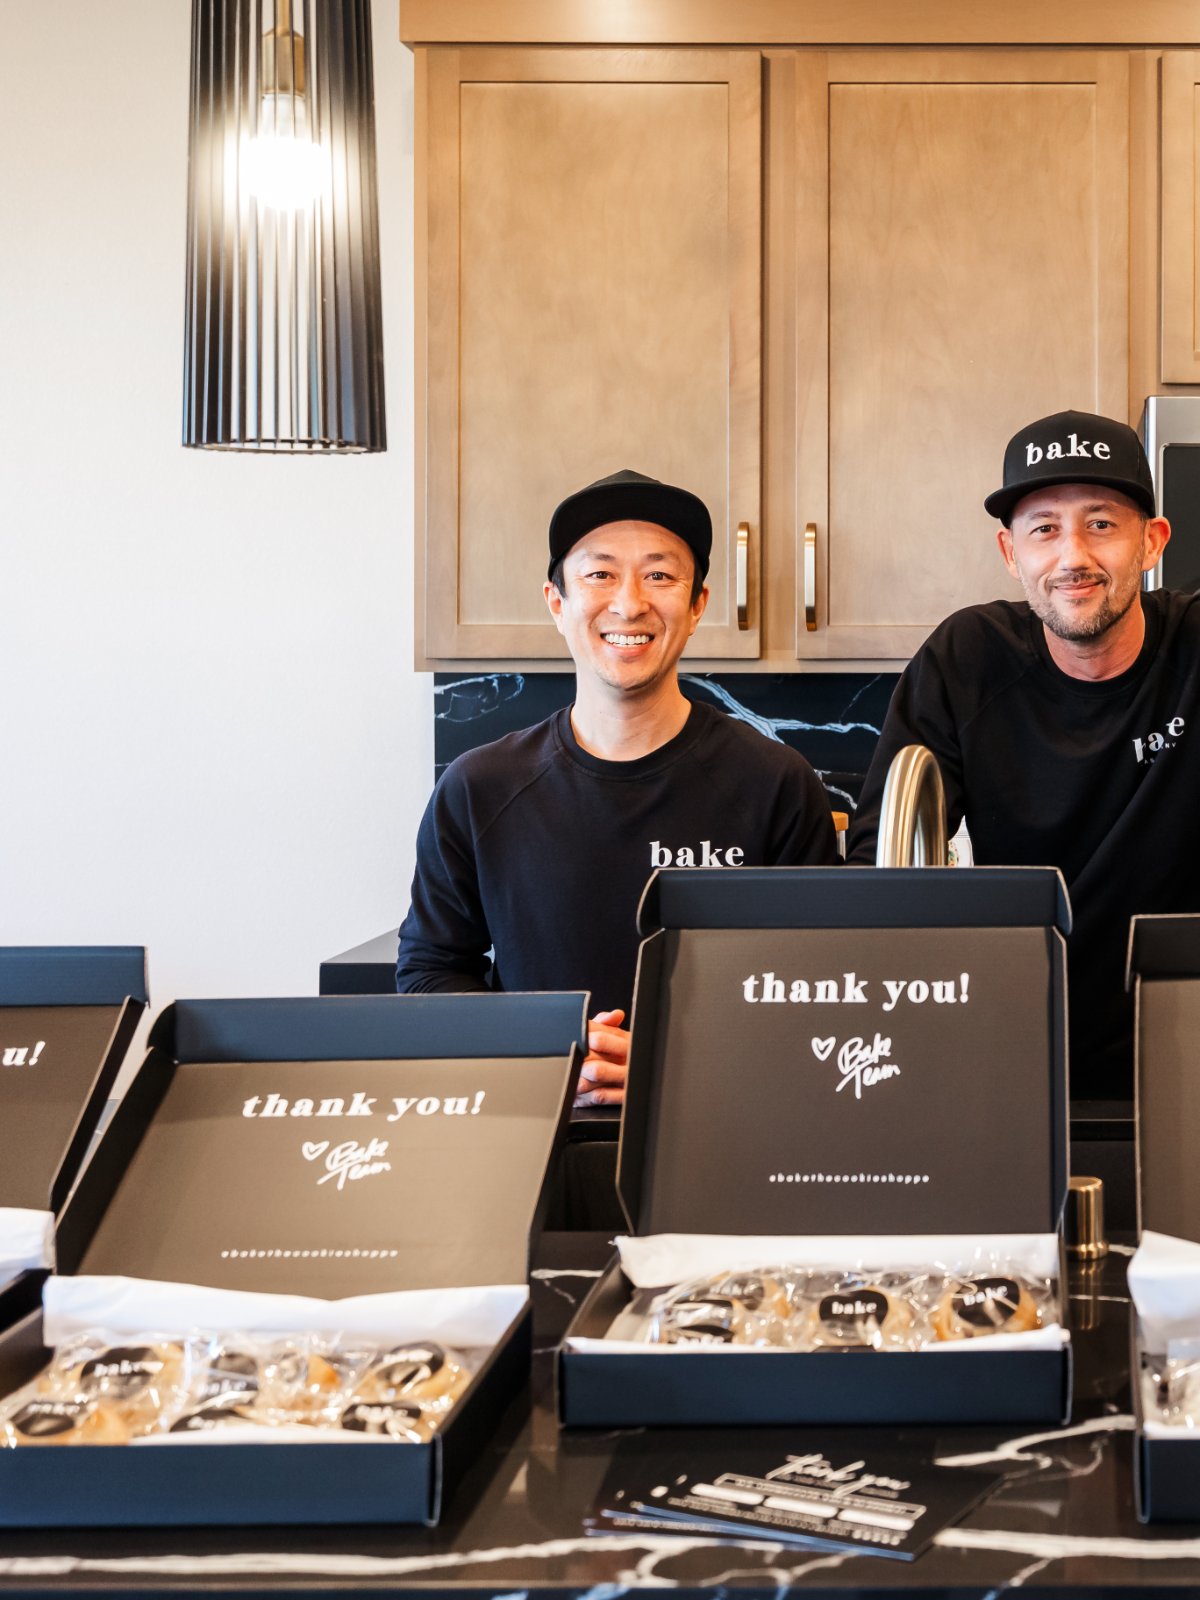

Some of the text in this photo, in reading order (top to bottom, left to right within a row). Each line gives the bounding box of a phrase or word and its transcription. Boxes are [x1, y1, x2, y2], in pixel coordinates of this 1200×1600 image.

[1025, 433, 1111, 467] bake
[649, 840, 745, 867] bake
[741, 973, 970, 1011] thank you!
[2, 1040, 46, 1067] u!
[837, 1033, 892, 1075] Bake
[836, 1062, 901, 1099] Team
[242, 1090, 486, 1123] thank you!
[324, 1137, 390, 1173] Bake
[317, 1158, 391, 1191] Team
[831, 1300, 878, 1315] bake
[962, 1285, 1009, 1307] bake
